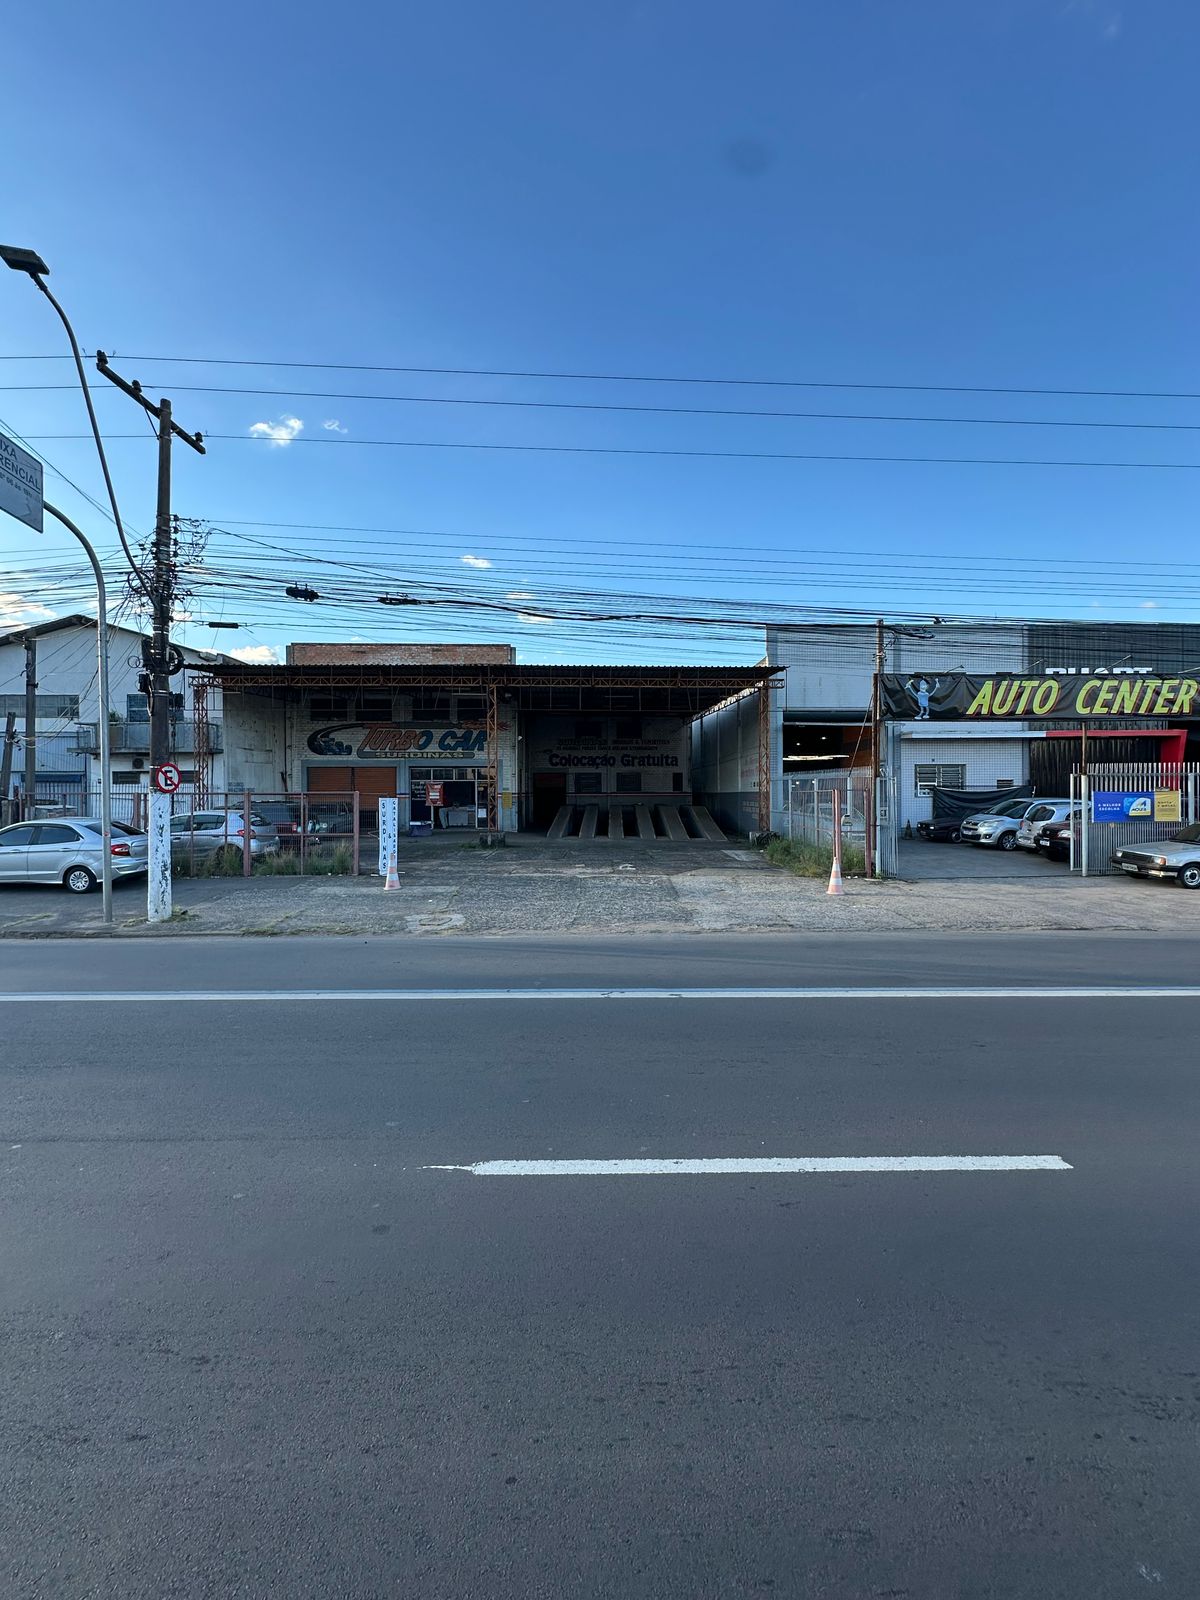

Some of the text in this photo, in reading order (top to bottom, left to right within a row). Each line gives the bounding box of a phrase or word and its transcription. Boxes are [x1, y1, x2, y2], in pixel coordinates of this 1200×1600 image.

[966, 679, 1199, 716] AUTO CENTER
[357, 722, 489, 752] TURBO CAR
[375, 751, 464, 759] SURDINAS
[549, 753, 678, 769] Colocação Gratuita
[164, 769, 173, 787] E
